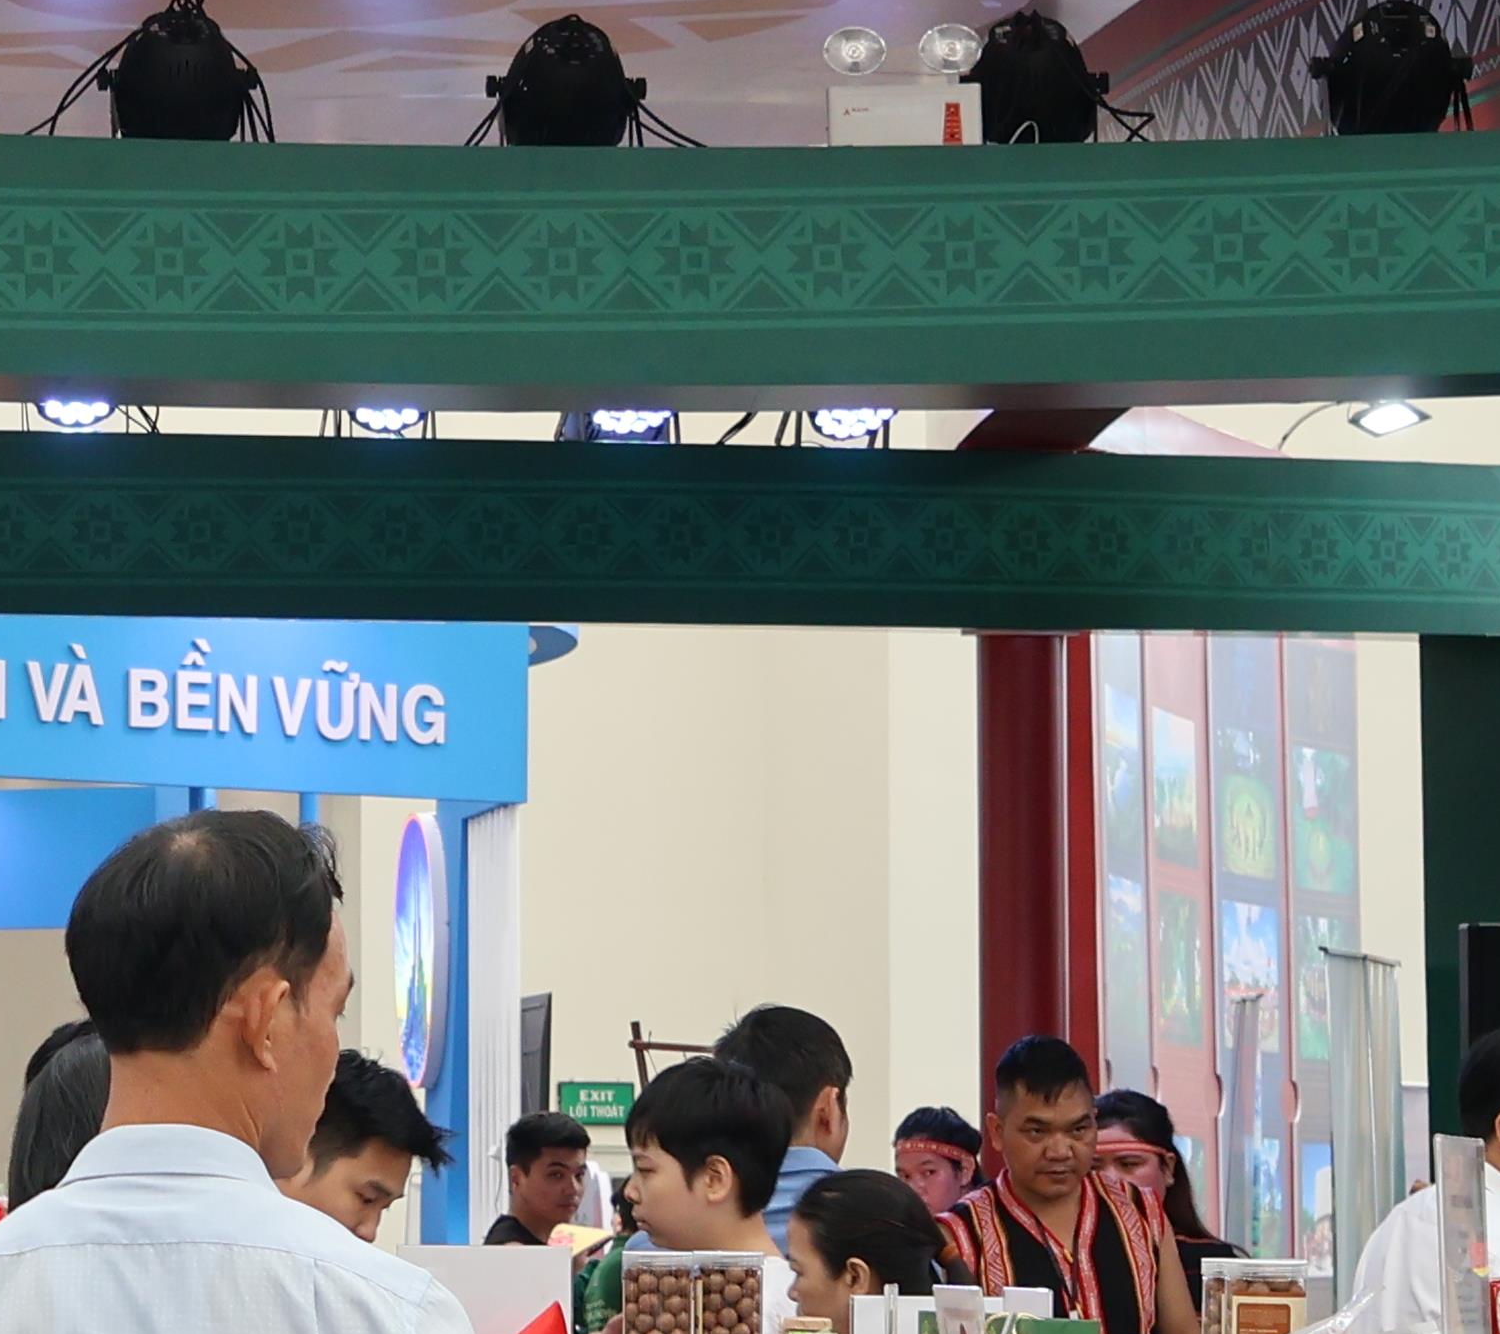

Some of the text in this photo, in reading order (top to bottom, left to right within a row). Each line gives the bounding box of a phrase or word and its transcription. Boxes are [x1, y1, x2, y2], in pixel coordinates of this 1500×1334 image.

[27, 642, 106, 727] VÀ
[126, 635, 260, 737] BỀN
[271, 657, 449, 749] VỮNG
[579, 1089, 615, 1102] EXIT
